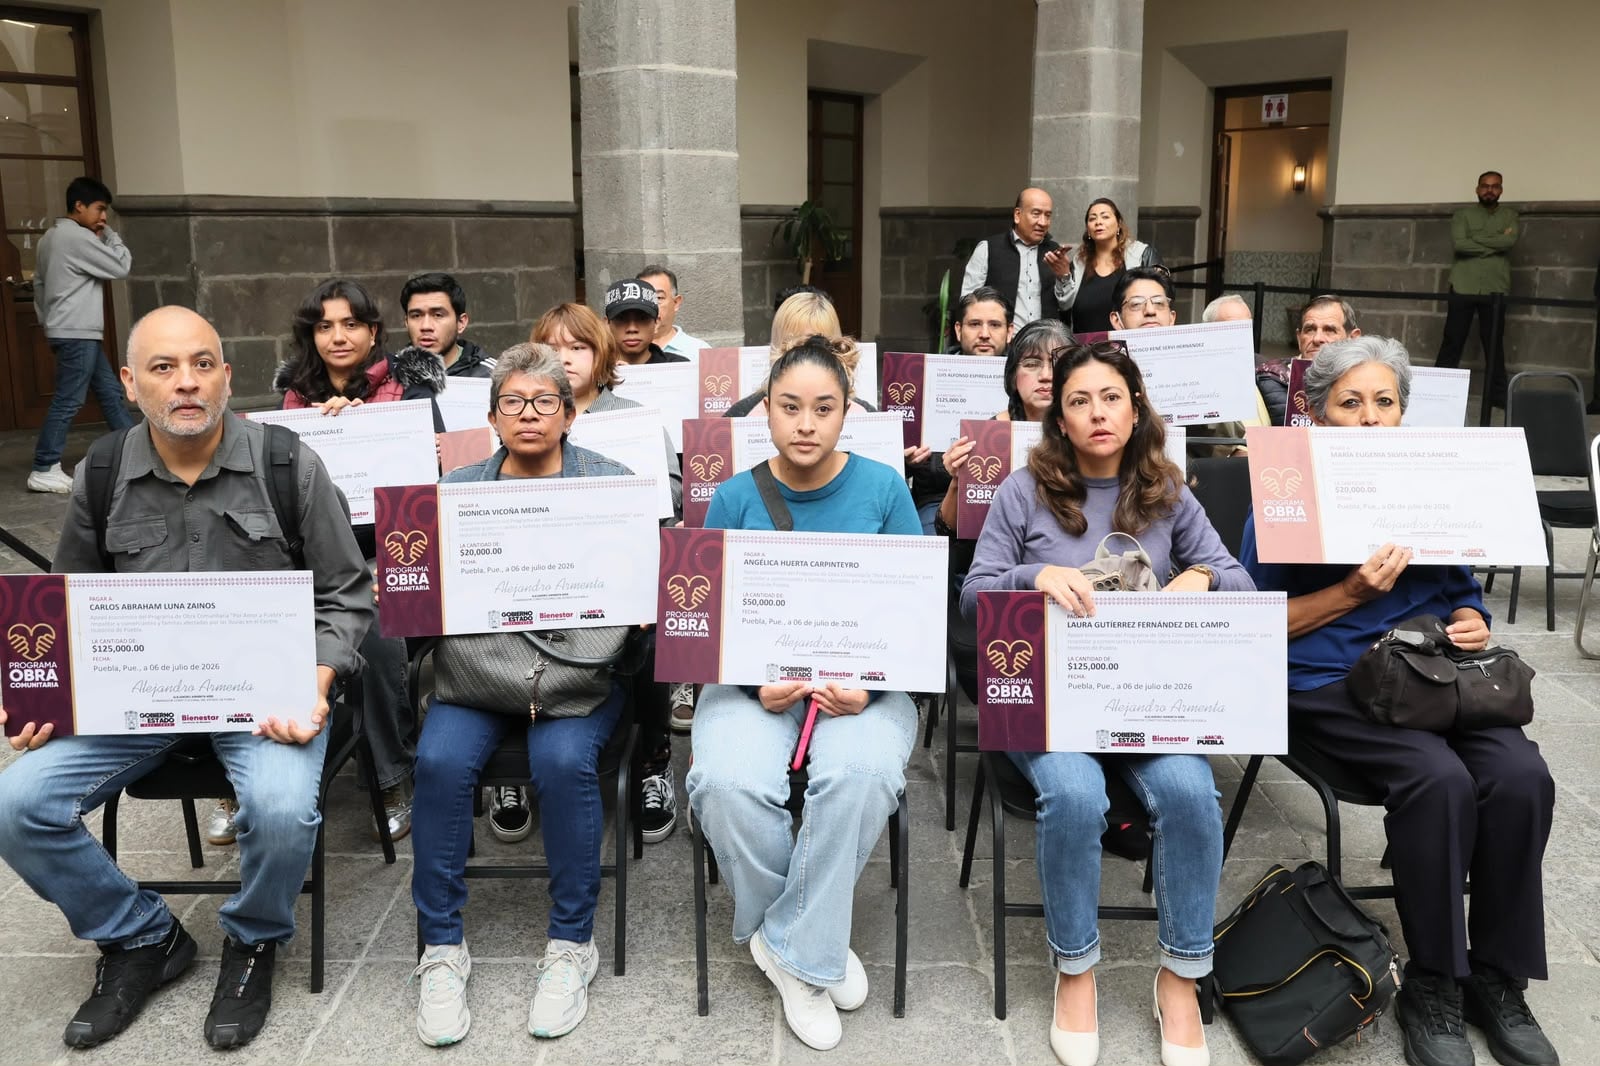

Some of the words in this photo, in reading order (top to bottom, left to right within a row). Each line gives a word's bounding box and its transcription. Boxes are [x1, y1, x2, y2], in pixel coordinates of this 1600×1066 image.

[623, 283, 640, 300] D
[704, 401, 732, 409] OBRA
[691, 488, 716, 497] OBR
[966, 489, 997, 499] OBR
[1264, 506, 1306, 517] OBRA
[460, 548, 502, 557] $20,000.00
[386, 573, 429, 586] OBRA
[494, 579, 551, 597] Alejandro
[555, 577, 604, 591] Armenta
[743, 598, 786, 607] $50,000.00
[665, 618, 709, 631] OBRA
[1094, 620, 1136, 628] GUTÍERREZ
[1138, 620, 1183, 628] FERNÁNDEZ
[775, 634, 833, 651] Alejandro
[837, 636, 888, 650] Armenta
[92, 645, 144, 653] $125,000.00
[1068, 662, 1119, 671] $125,000.00
[9, 669, 58, 681] OBRA
[132, 679, 196, 697] Alejandro
[199, 679, 254, 693] Armenta
[987, 685, 1033, 698] OBRA
[1145, 683, 1161, 691] julio
[1104, 698, 1166, 716] Alejandro
[1170, 699, 1225, 713] Armenta
